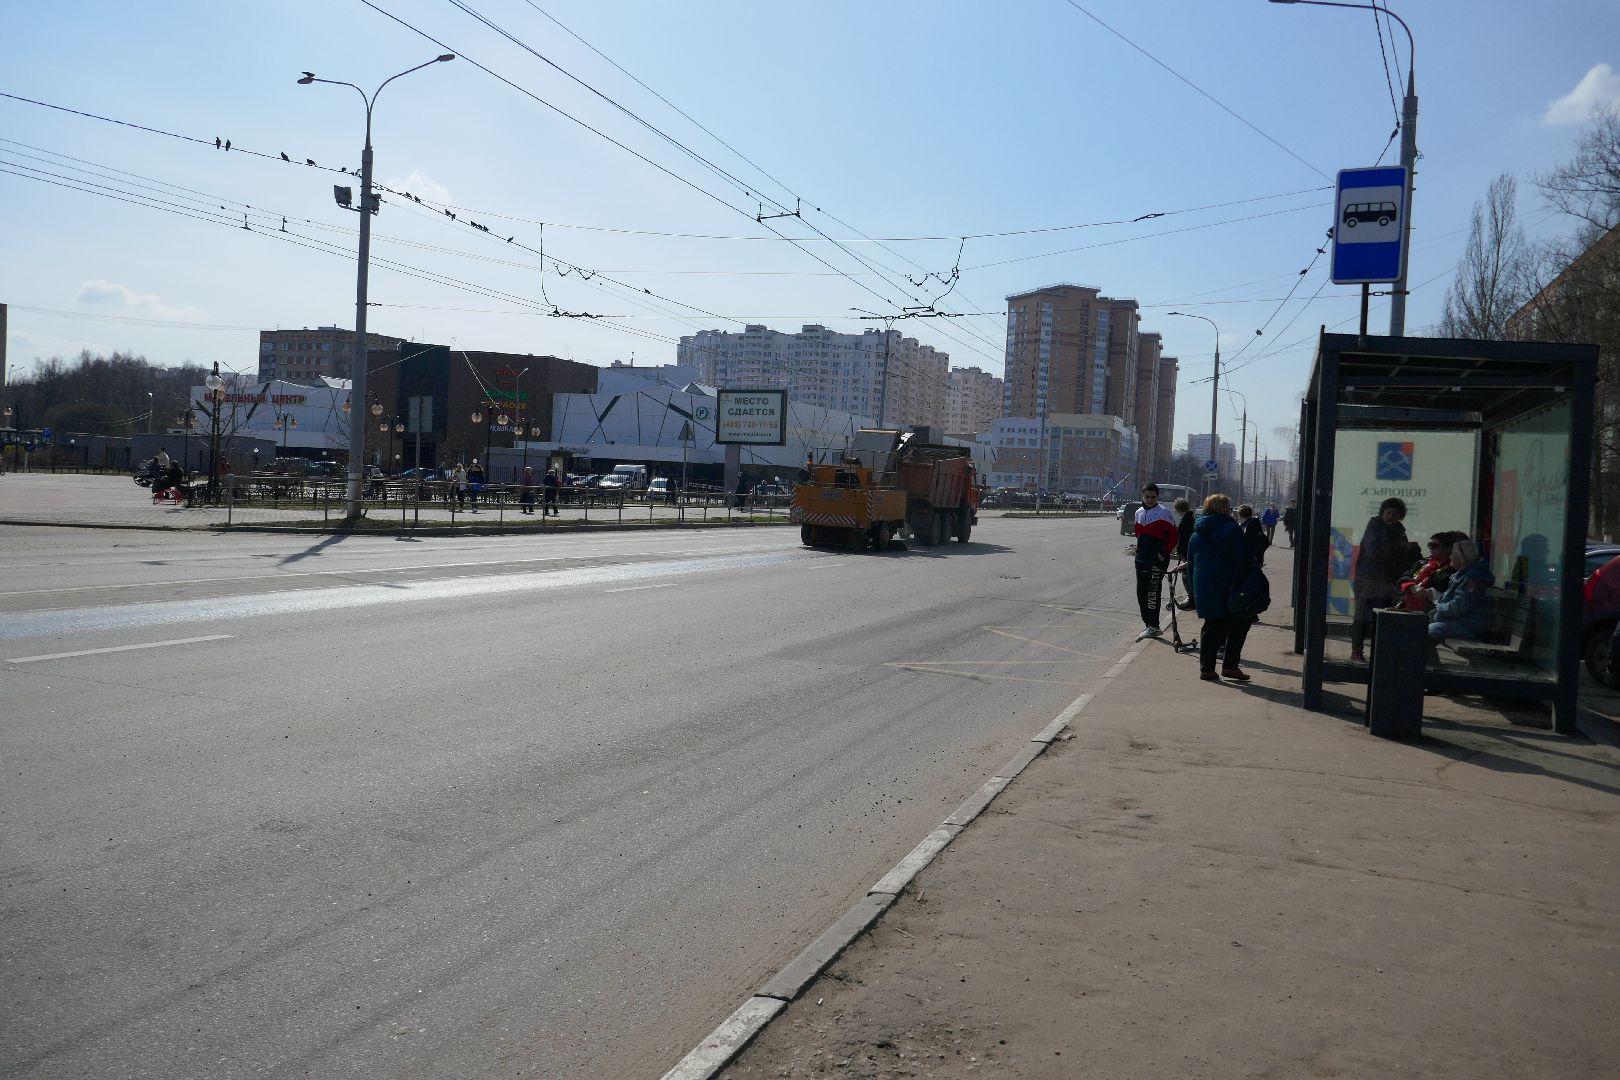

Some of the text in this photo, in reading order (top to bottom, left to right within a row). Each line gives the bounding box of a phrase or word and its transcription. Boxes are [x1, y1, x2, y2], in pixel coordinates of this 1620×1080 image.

[204, 392, 305, 404] МЕЛЬНЫЙ ЦЕНТР
[734, 397, 769, 405] МЕСТО
[728, 408, 775, 416] СДАЕТСЯ
[490, 424, 516, 433] ЛОМБА
